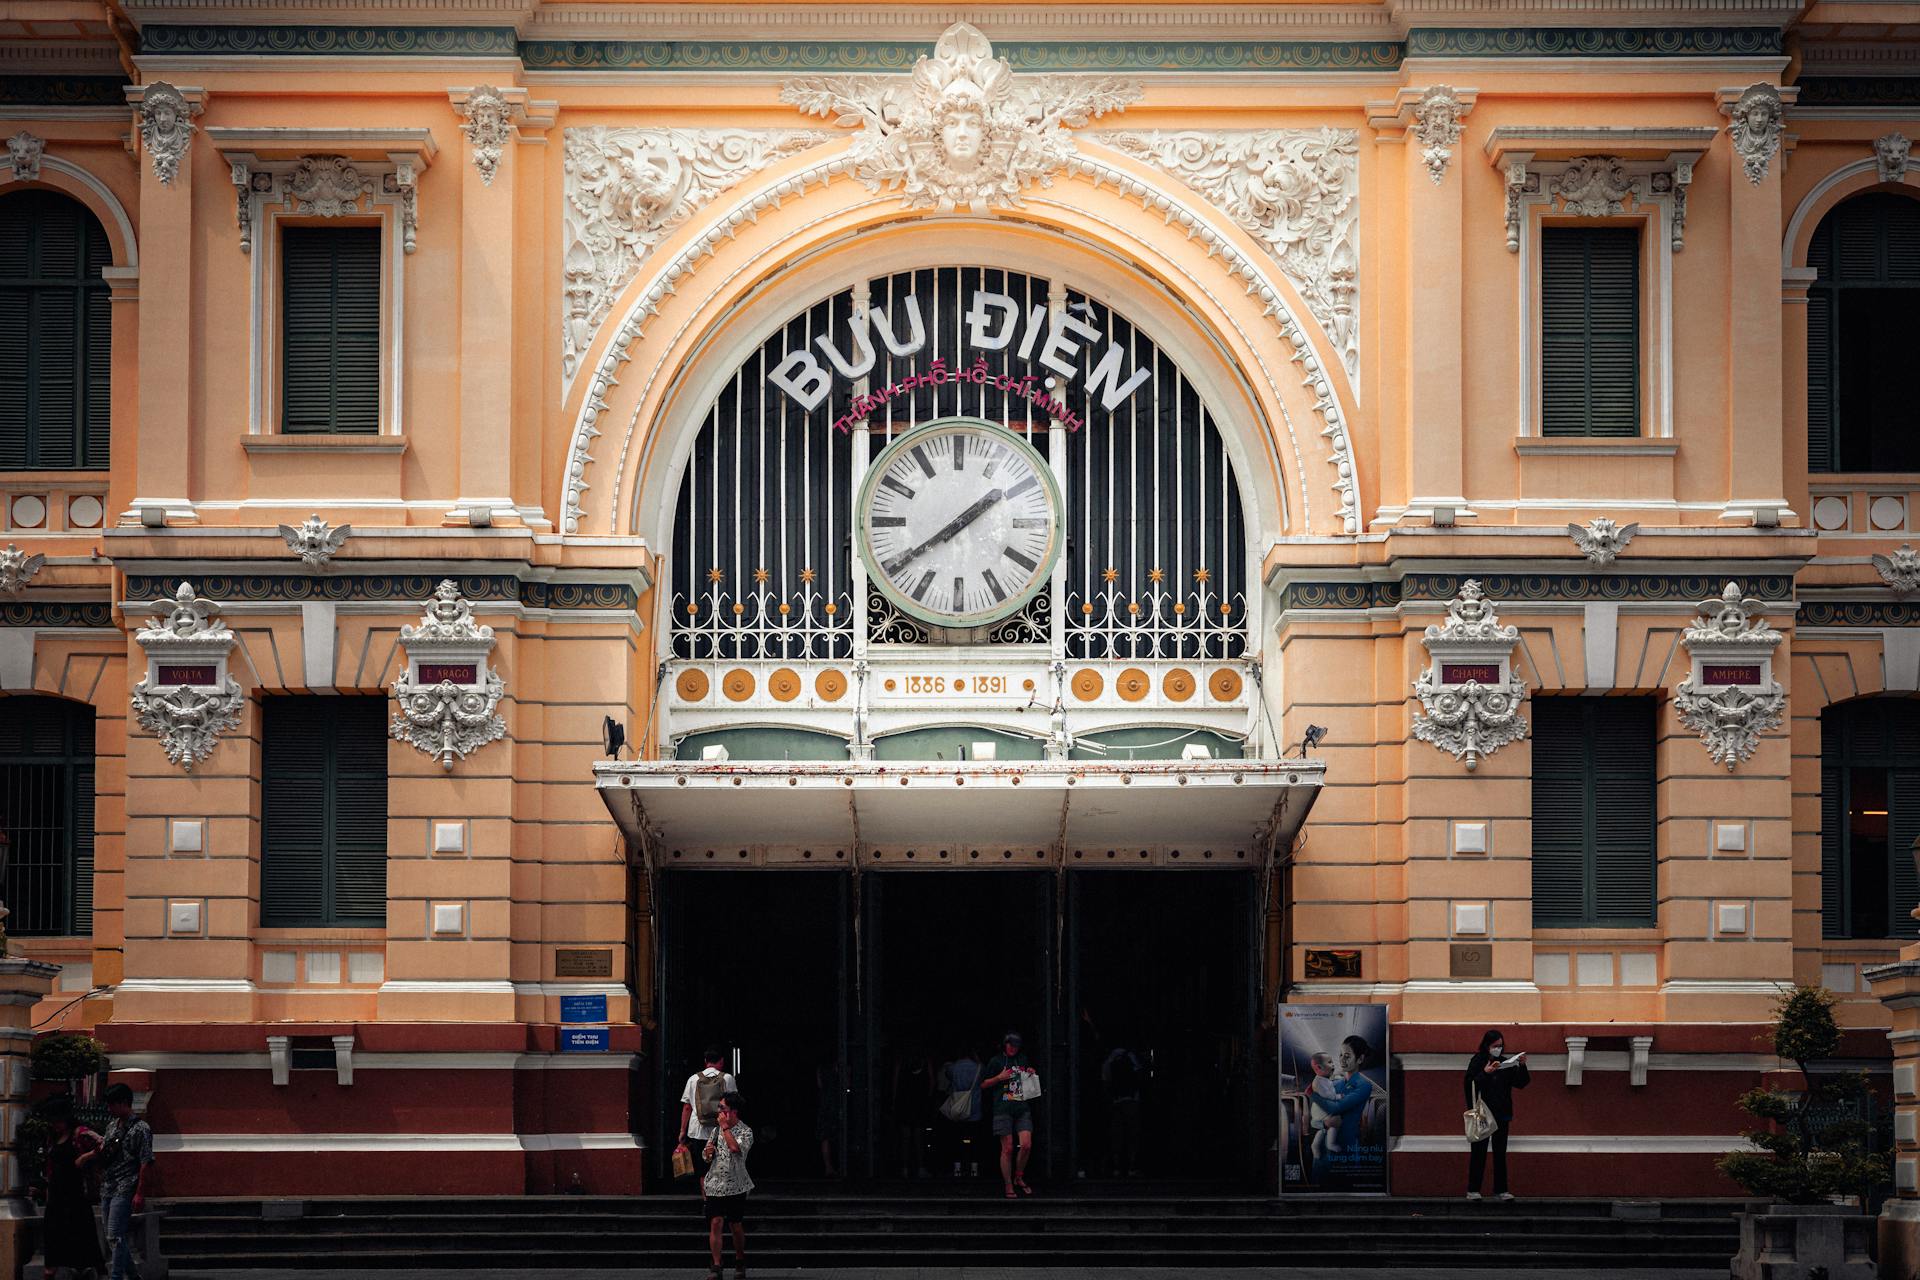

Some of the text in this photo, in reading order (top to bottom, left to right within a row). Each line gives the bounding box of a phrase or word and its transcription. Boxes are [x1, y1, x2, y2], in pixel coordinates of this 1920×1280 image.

[965, 290, 1152, 415] ĐIỆN
[902, 357, 948, 394] PHỐ
[1031, 388, 1085, 433] MINH
[172, 670, 202, 679] VOLTA
[437, 669, 468, 679] ARAGO
[1452, 668, 1489, 679] CHAPPE
[904, 675, 1007, 694] 1886 1891
